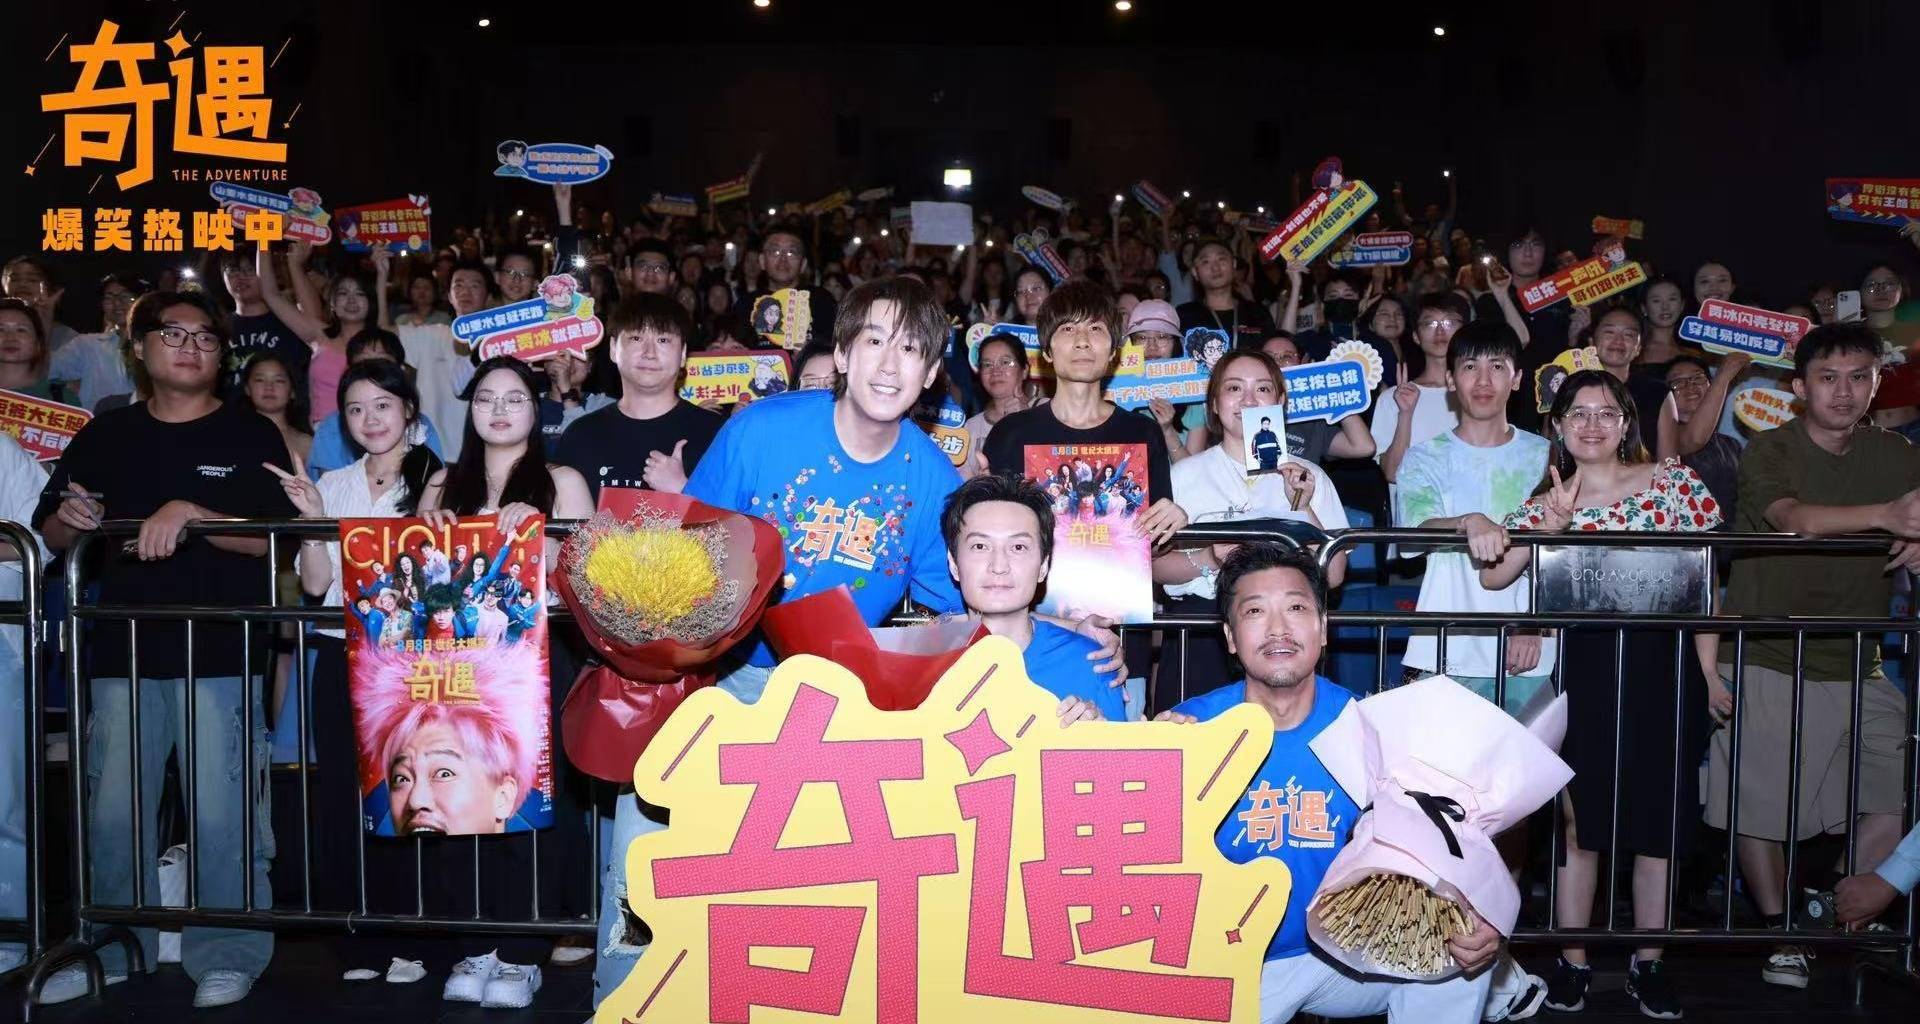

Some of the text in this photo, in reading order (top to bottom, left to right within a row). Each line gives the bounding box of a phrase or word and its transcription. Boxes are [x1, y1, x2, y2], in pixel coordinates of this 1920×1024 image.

[800, 497, 876, 565] 奇遇
[403, 655, 481, 705] 奇遇
[1238, 780, 1335, 850] 奇遇
[652, 683, 1234, 1024] 奇遇
